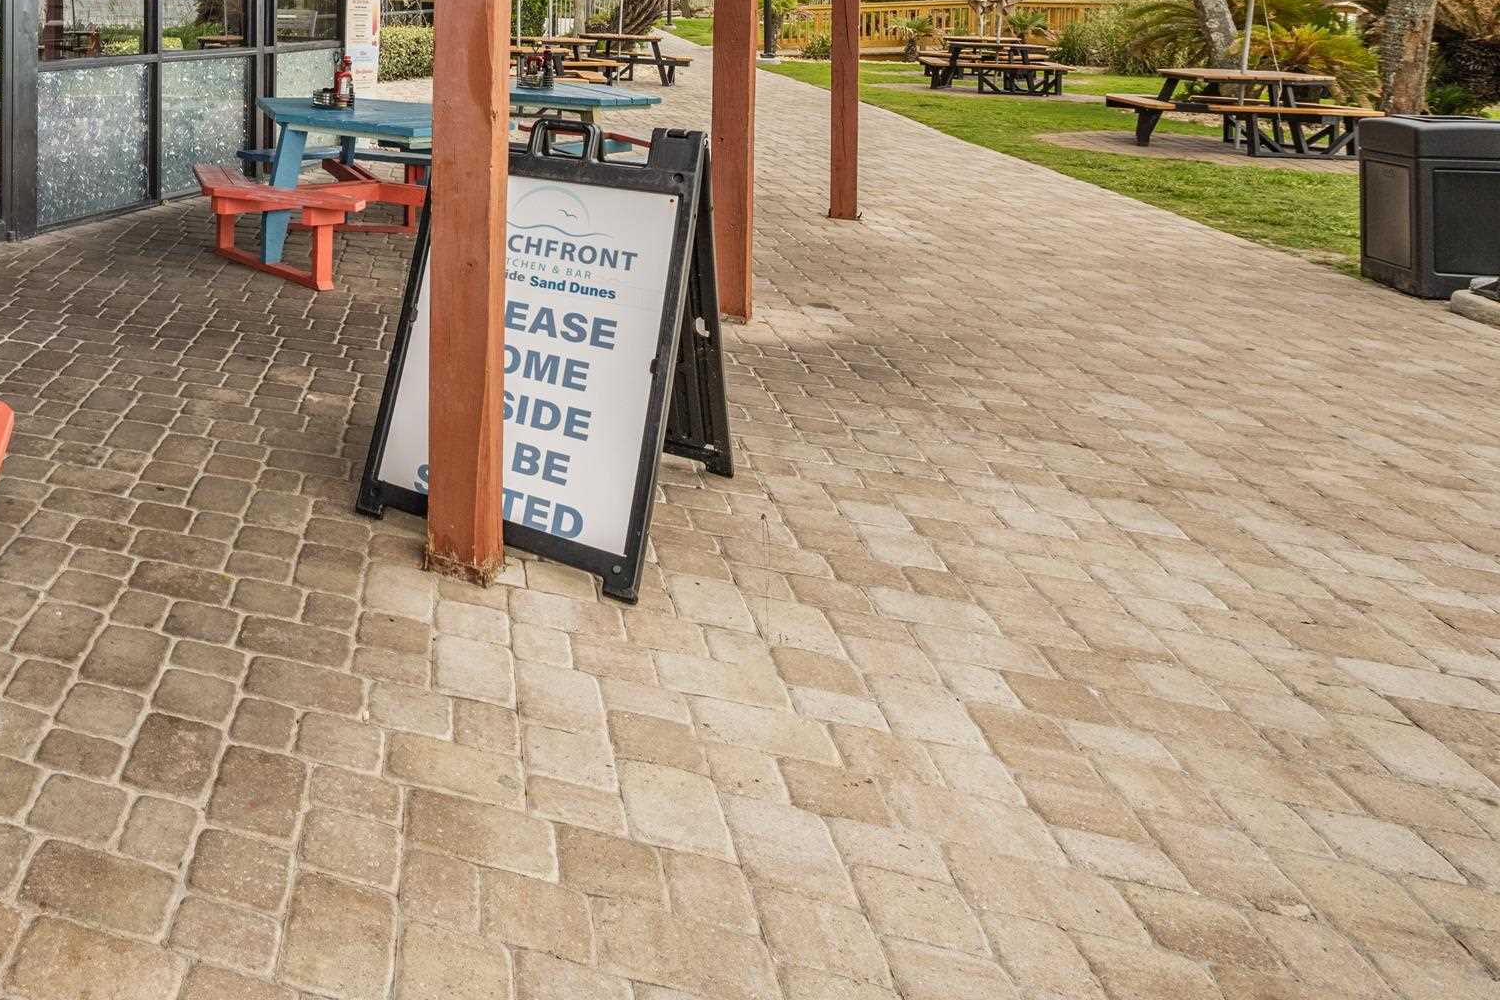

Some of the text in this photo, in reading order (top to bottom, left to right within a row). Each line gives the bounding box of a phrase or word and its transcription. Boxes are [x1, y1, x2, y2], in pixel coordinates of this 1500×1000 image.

[506, 257, 592, 279] TCHEN & BAR
[507, 234, 638, 271] CHFRONT
[530, 275, 566, 292] Sand
[569, 282, 616, 300] Dunes
[503, 300, 618, 350] EASE
[503, 344, 590, 392] OME
[503, 390, 591, 441] SIDE
[511, 442, 571, 486] BE
